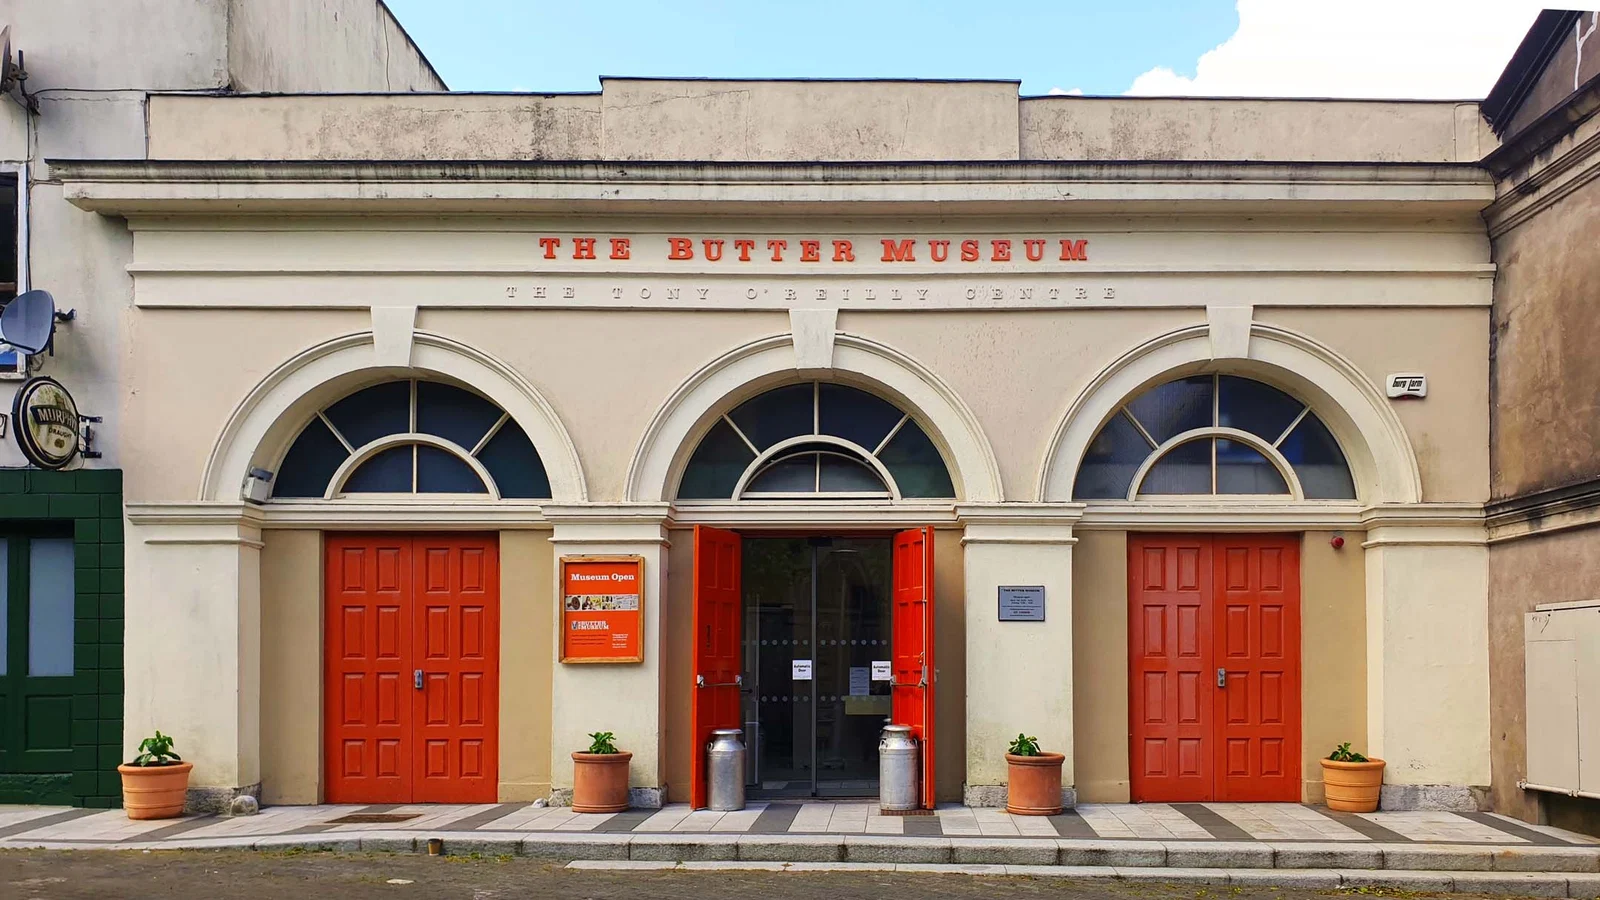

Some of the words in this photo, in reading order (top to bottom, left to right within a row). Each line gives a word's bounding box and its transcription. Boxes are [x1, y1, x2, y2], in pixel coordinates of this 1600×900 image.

[539, 237, 631, 260] THE
[667, 237, 856, 262] BUTTER
[880, 238, 1089, 262] MUSEUM
[506, 286, 575, 299] THE
[611, 287, 709, 300] TONY
[745, 287, 929, 301] O'REILLY
[965, 288, 1116, 301] CENTRE
[48, 427, 73, 439] DRAUGHT
[611, 573, 635, 582] Open
